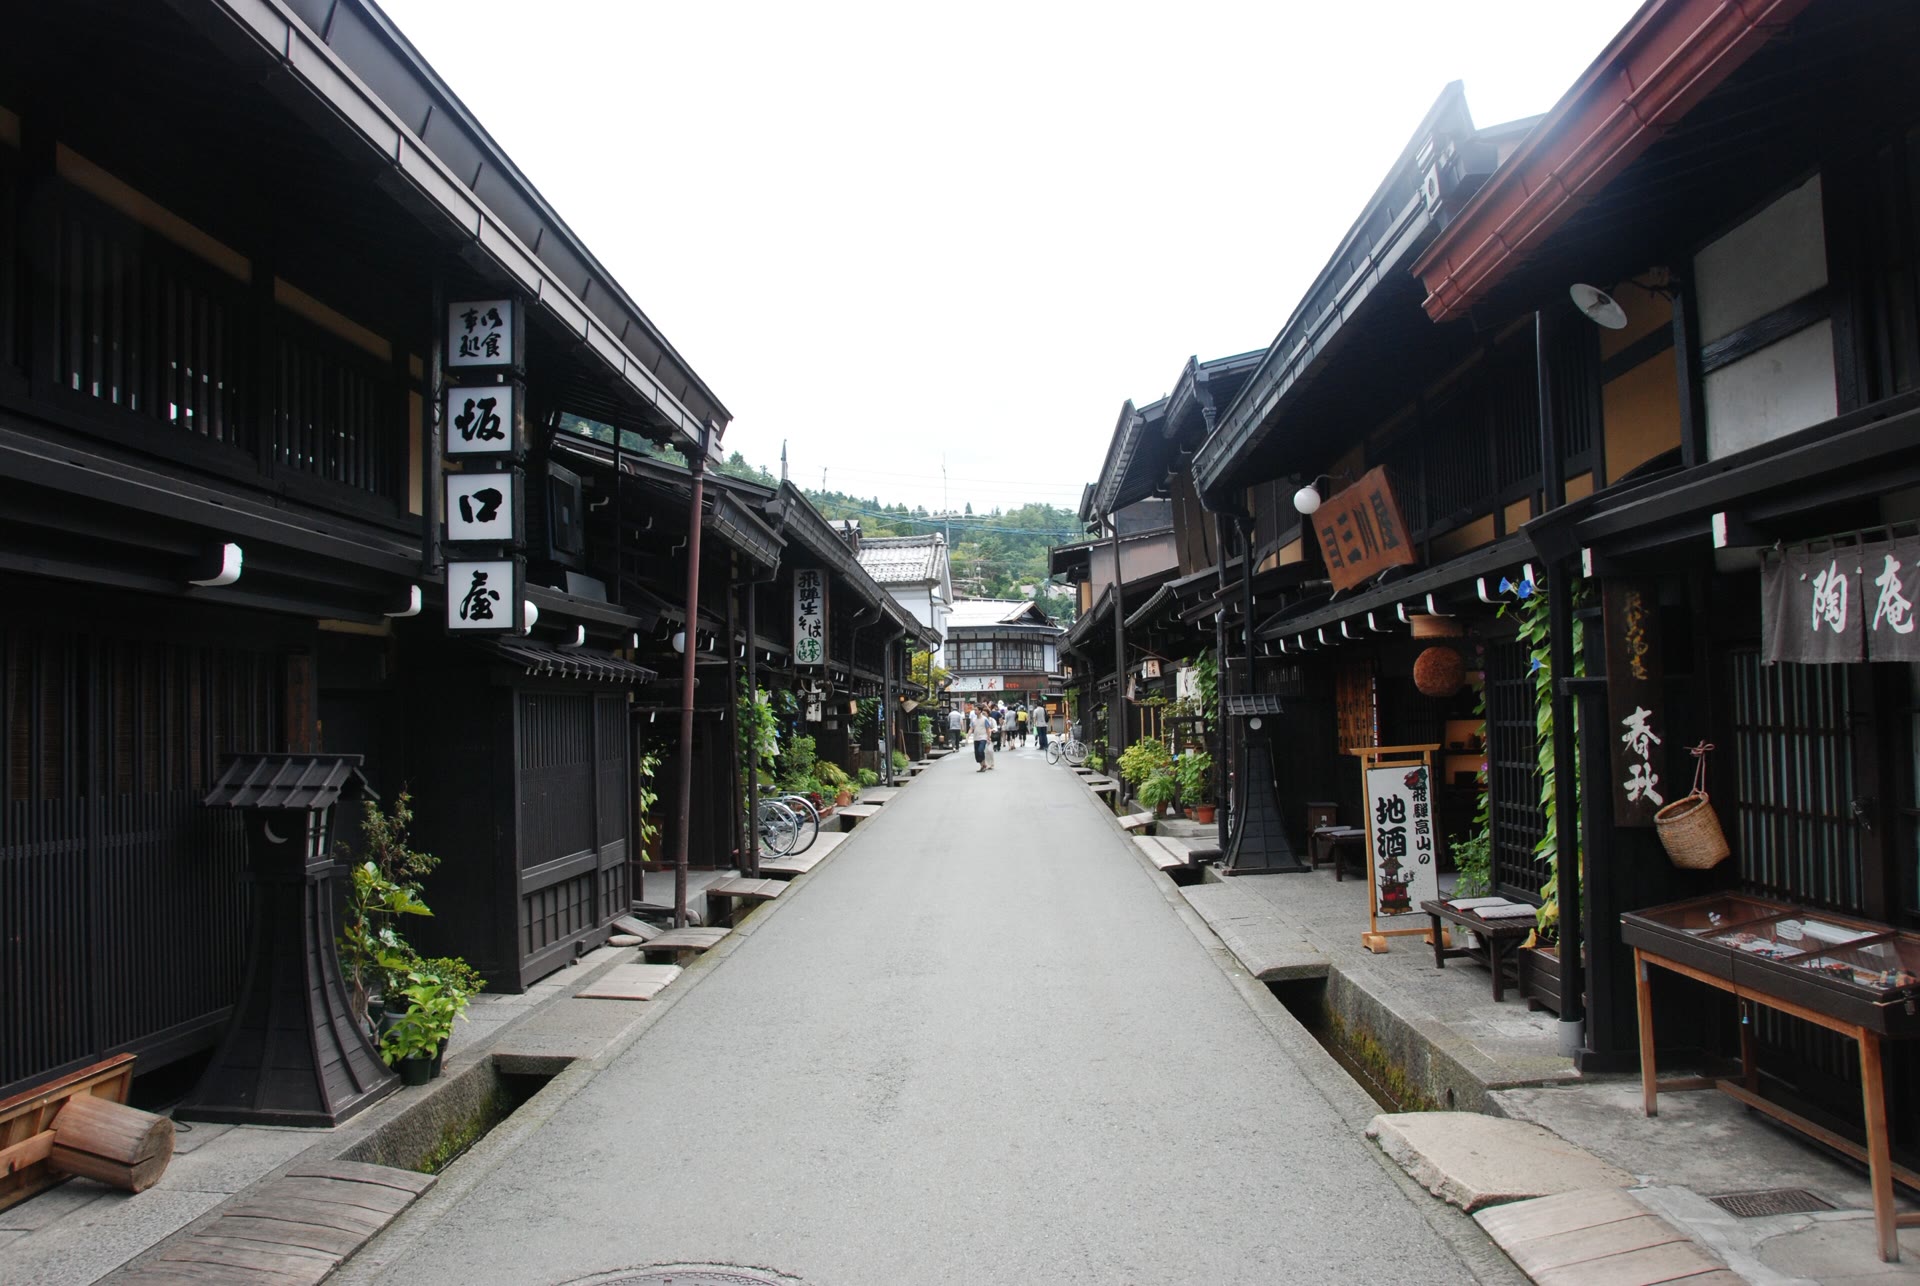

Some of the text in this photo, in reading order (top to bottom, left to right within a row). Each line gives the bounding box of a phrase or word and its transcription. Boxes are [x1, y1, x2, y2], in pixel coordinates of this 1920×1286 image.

[454, 396, 506, 621] 坂口屋
[1621, 705, 1664, 806] 春秋
[1376, 794, 1407, 858] 地酒
[1412, 788, 1431, 865] 飛騨高山の
